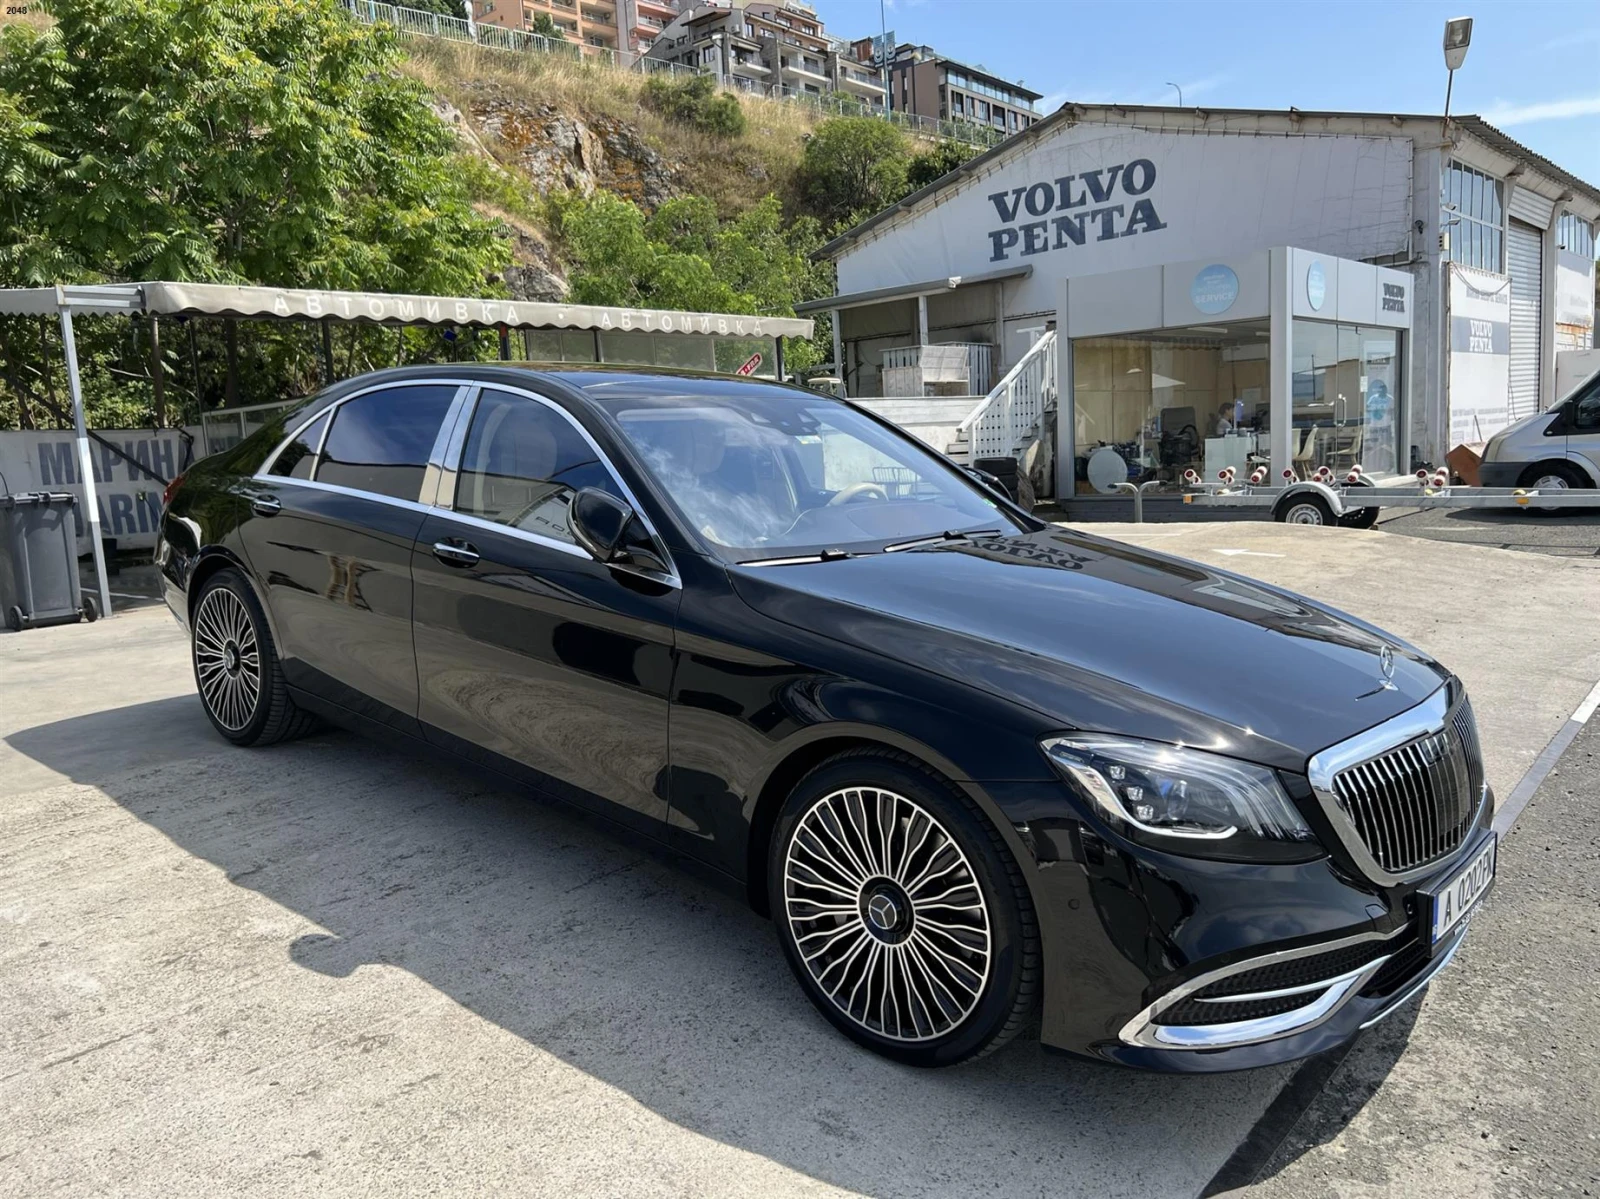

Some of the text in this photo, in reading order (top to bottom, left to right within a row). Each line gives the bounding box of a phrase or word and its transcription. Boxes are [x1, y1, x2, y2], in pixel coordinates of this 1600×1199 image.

[988, 158, 1157, 223] VOLVO
[988, 198, 1167, 262] PENTA
[1195, 291, 1236, 303] SERVICE
[1383, 282, 1405, 299] VOLVO
[274, 295, 519, 323] АВТОМИВКА
[601, 312, 763, 335] АВТОМИВКА
[1469, 319, 1493, 338] VOLVO
[1469, 336, 1493, 353] PENTA
[1443, 889, 1452, 928] A
